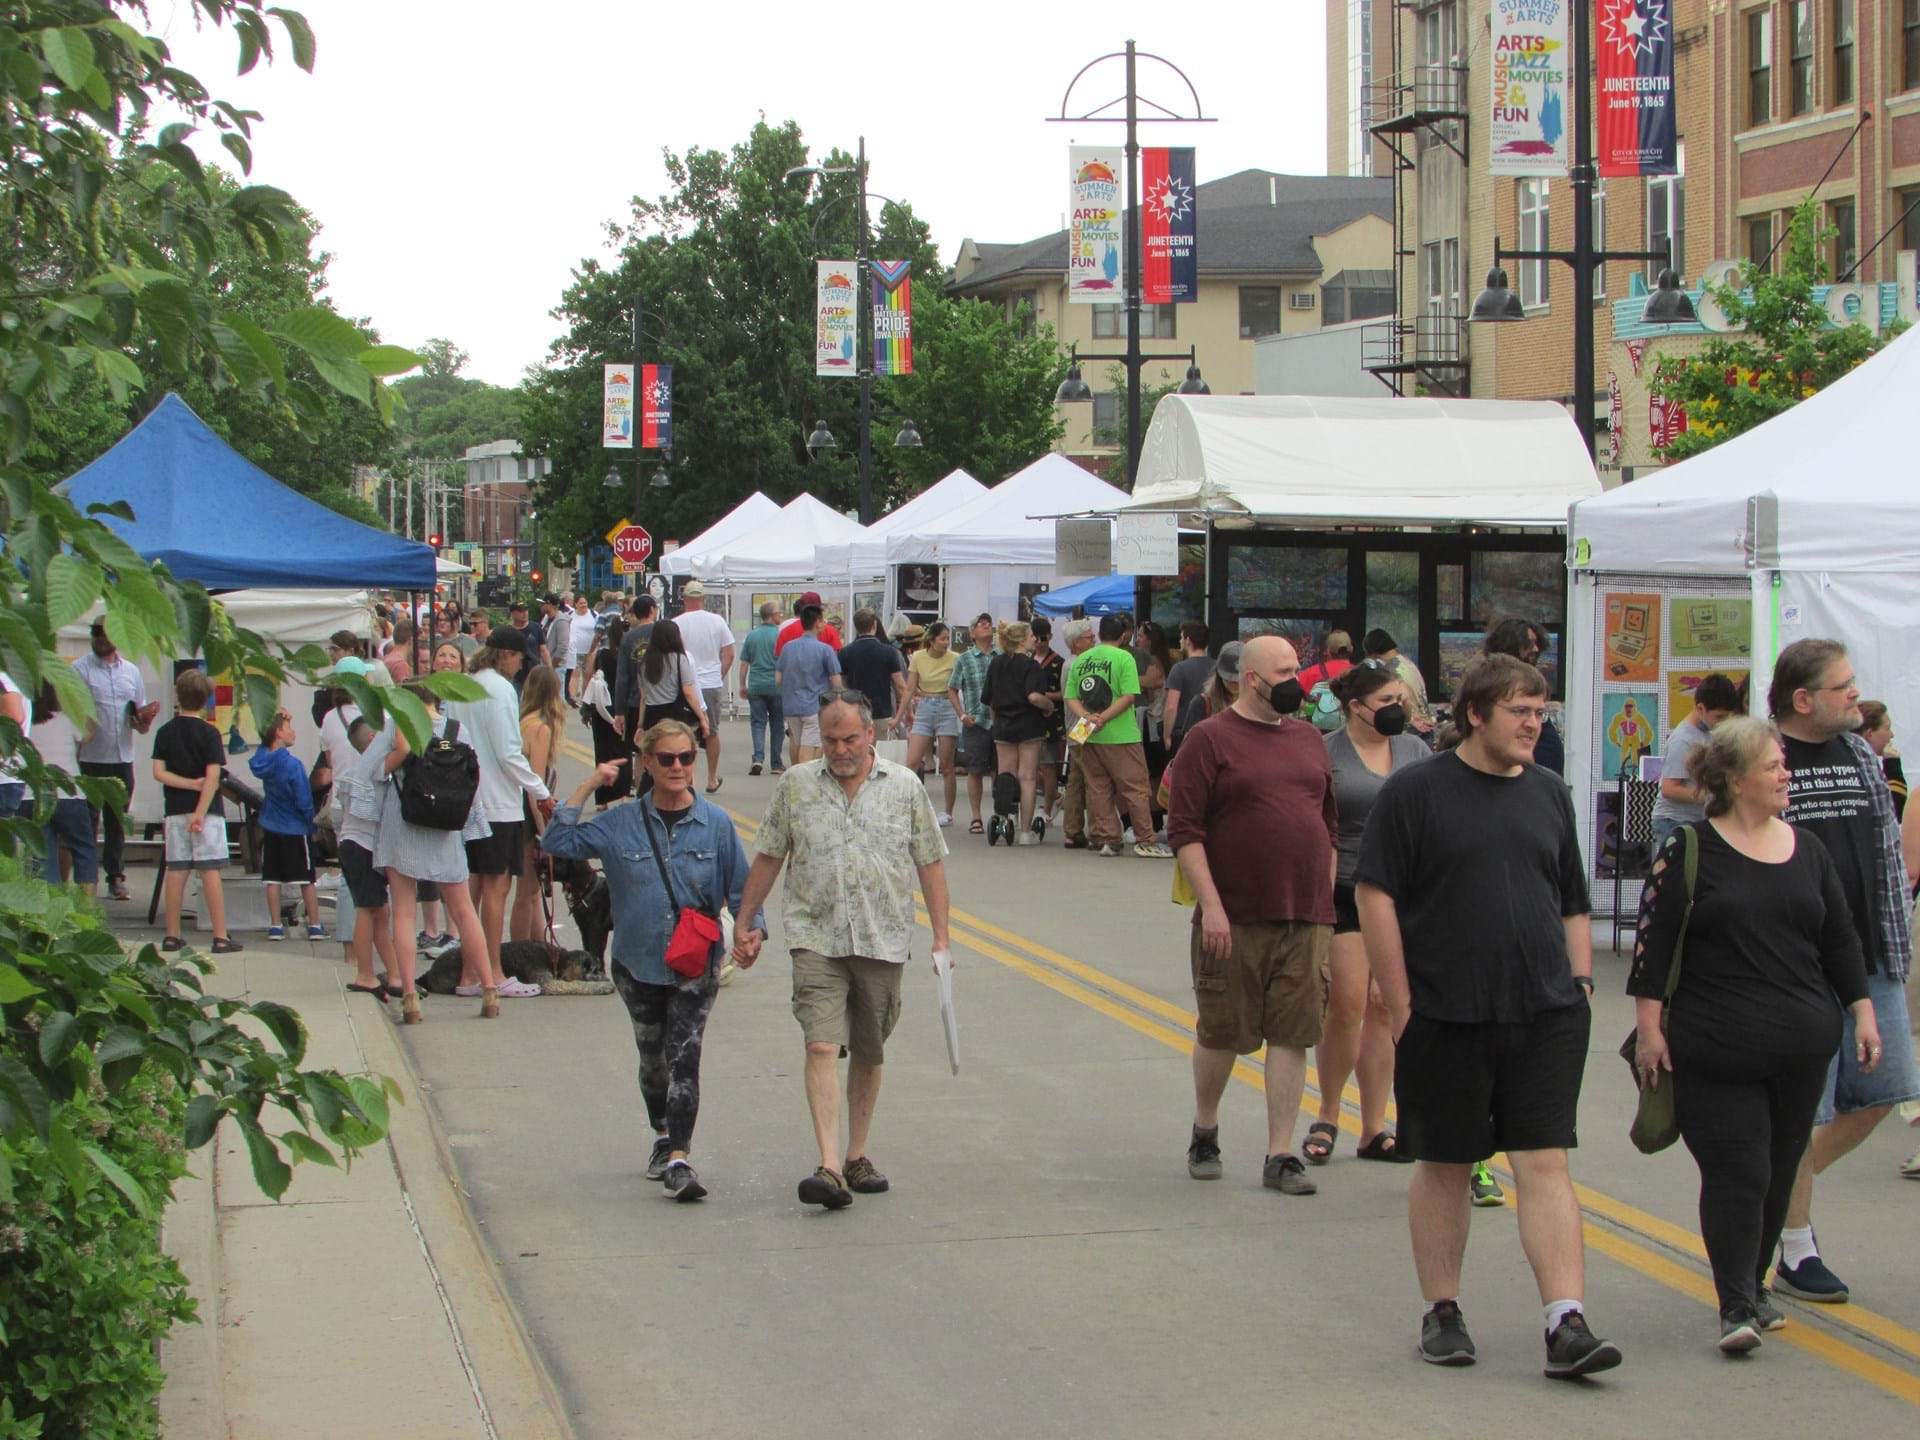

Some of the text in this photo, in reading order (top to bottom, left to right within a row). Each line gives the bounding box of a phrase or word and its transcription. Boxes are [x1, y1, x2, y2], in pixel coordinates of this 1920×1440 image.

[1499, 0, 1560, 15] SUMMER
[1516, 10, 1554, 25] ARTS
[1497, 35, 1545, 51] ARTS
[1507, 53, 1550, 69] JAZZ
[1494, 53, 1507, 107] MUSIC
[1508, 70, 1563, 83] MOVIES
[1602, 76, 1670, 92] JUNETEENTH
[1509, 85, 1526, 106] &
[1609, 97, 1630, 109] June
[1644, 96, 1664, 108] 1865
[1493, 108, 1528, 122] FUN
[1074, 182, 1117, 194] SUMMER
[1087, 191, 1113, 201] ARTS
[1073, 208, 1107, 219] ARTS
[1082, 221, 1110, 231] JAZZ
[1072, 221, 1081, 257] MUSIC
[1081, 232, 1119, 241] MOVIES
[1146, 235, 1193, 246] JUNETEENTH
[1071, 258, 1096, 267] FUN
[821, 307, 845, 315] ARTS
[874, 317, 910, 331] PRIDE
[875, 330, 892, 339] IOWA
[818, 342, 837, 350] FUN
[616, 538, 649, 552] STOP
[1084, 679, 1092, 688] 8
[1794, 765, 1856, 777] are two types
[1802, 780, 1812, 790] in
[1815, 778, 1834, 788] this
[1801, 801, 1818, 810] who
[1833, 799, 1869, 808] extrapolate
[1798, 809, 1839, 820] incomplete
[1841, 808, 1857, 817] data
